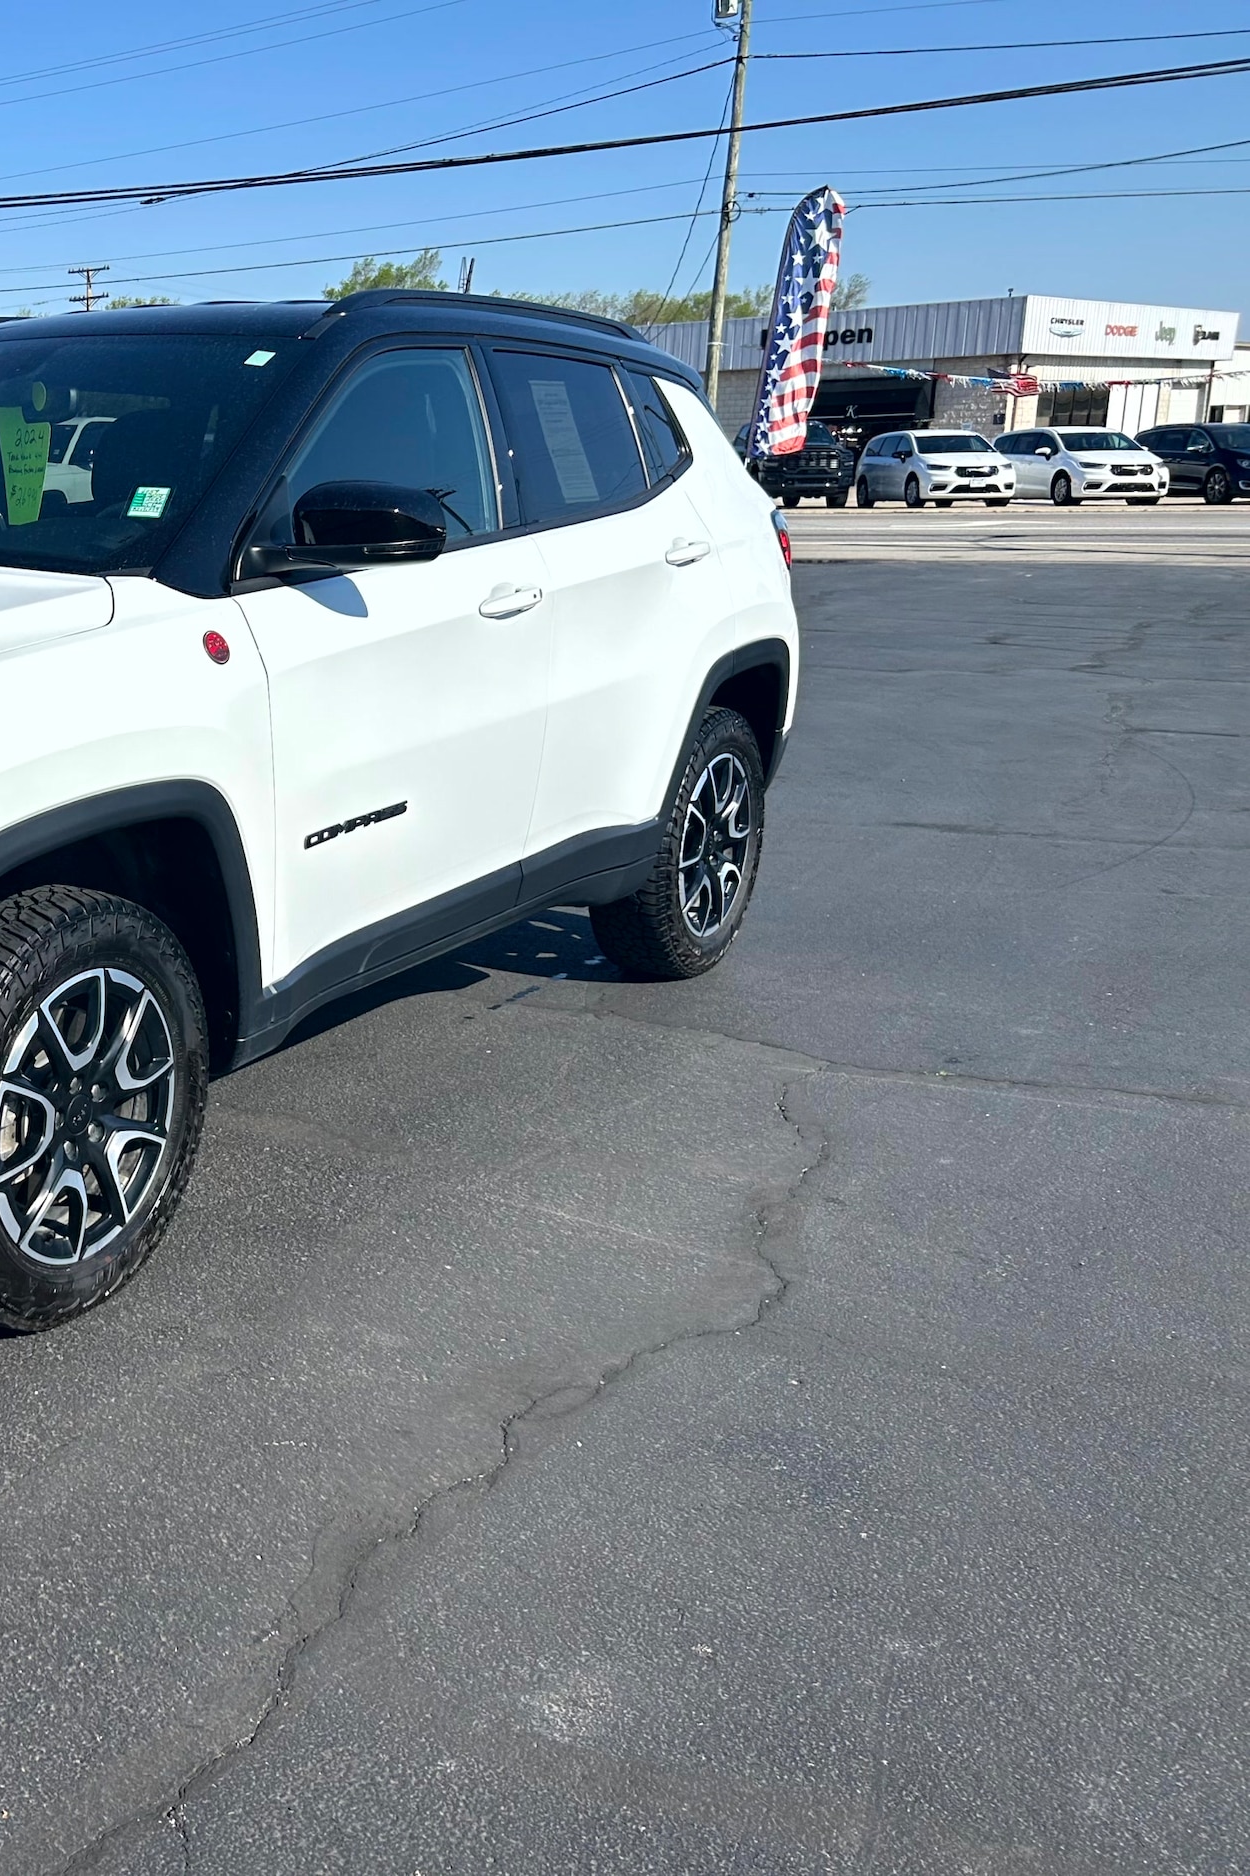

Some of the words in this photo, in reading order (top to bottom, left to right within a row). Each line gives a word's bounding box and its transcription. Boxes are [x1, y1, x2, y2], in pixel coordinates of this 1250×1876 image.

[1050, 317, 1085, 326] CHRYSLER
[1105, 324, 1138, 337] DODGE
[14, 427, 45, 449] 2024
[304, 800, 408, 850] COMPASS
